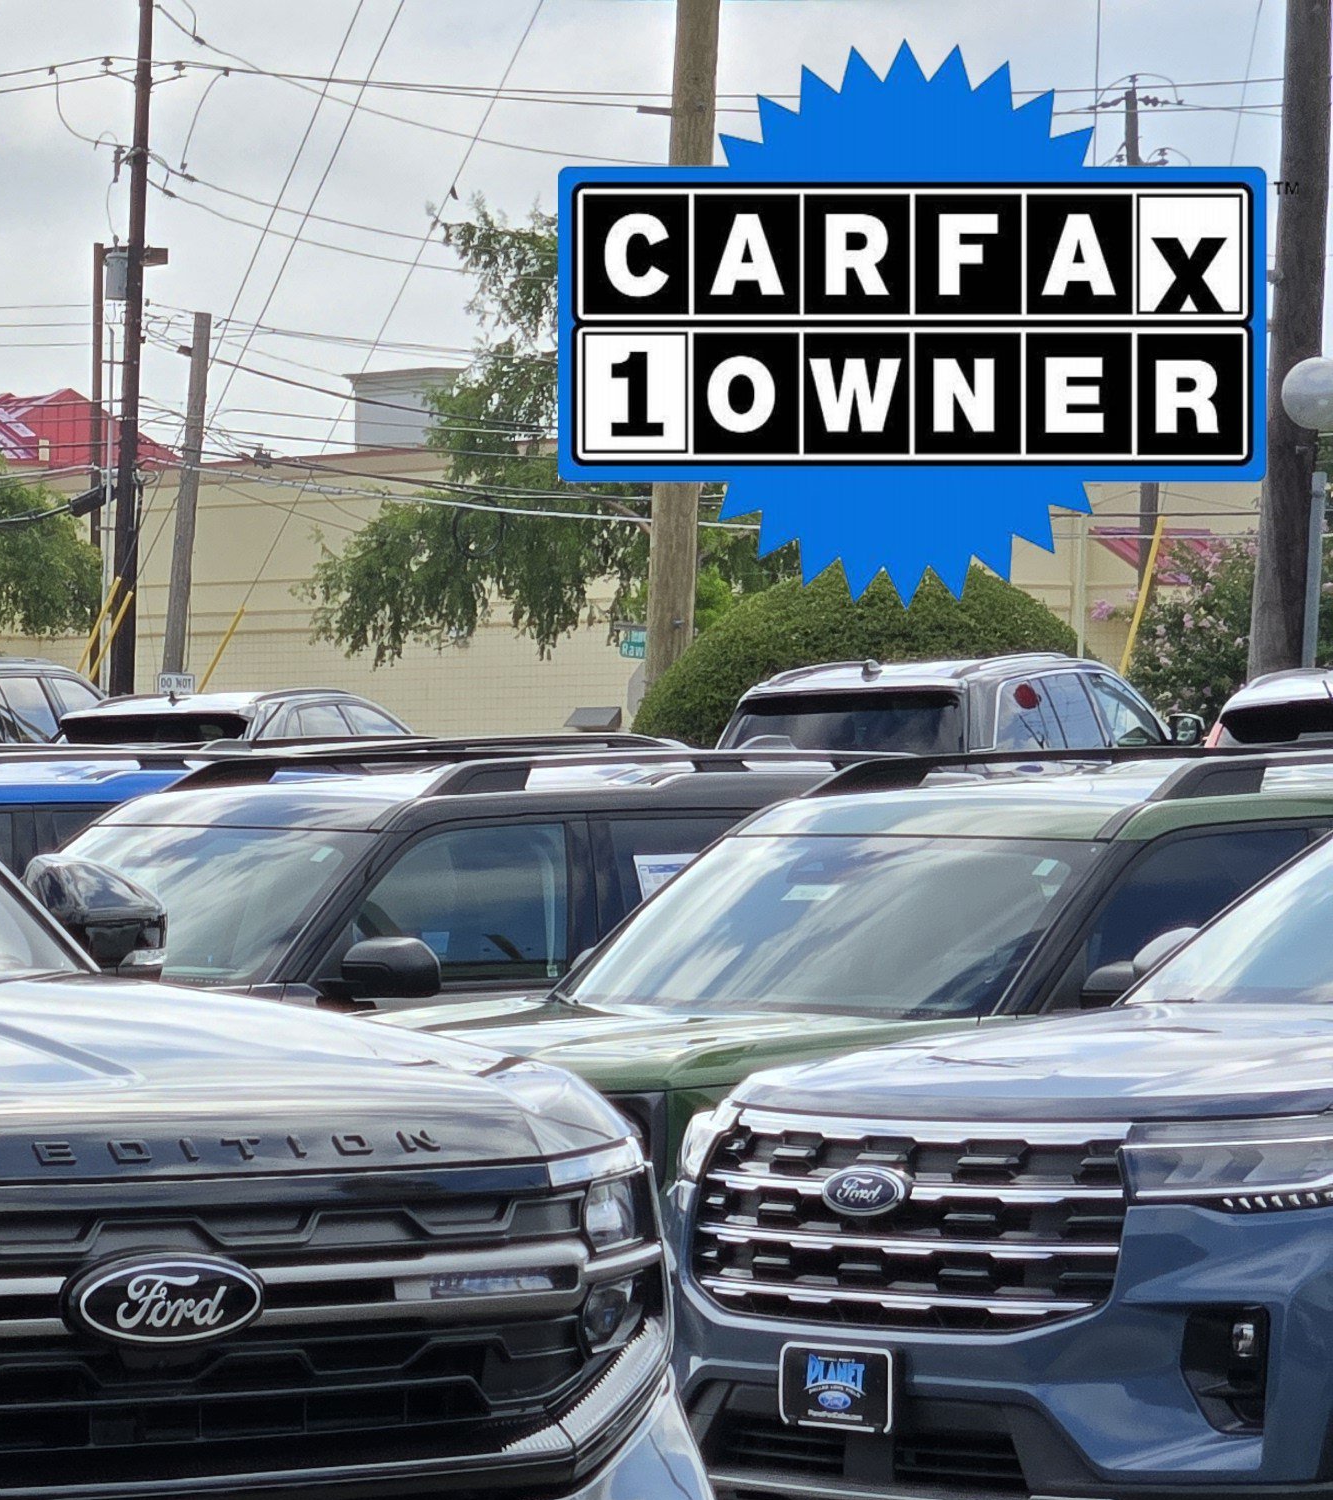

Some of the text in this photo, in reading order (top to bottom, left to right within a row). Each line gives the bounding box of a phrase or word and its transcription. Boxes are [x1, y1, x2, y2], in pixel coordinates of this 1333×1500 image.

[161, 677, 172, 688] DO
[836, 1176, 883, 1202] Ford
[116, 1273, 228, 1329] Ford
[806, 1353, 865, 1391] PLANET
